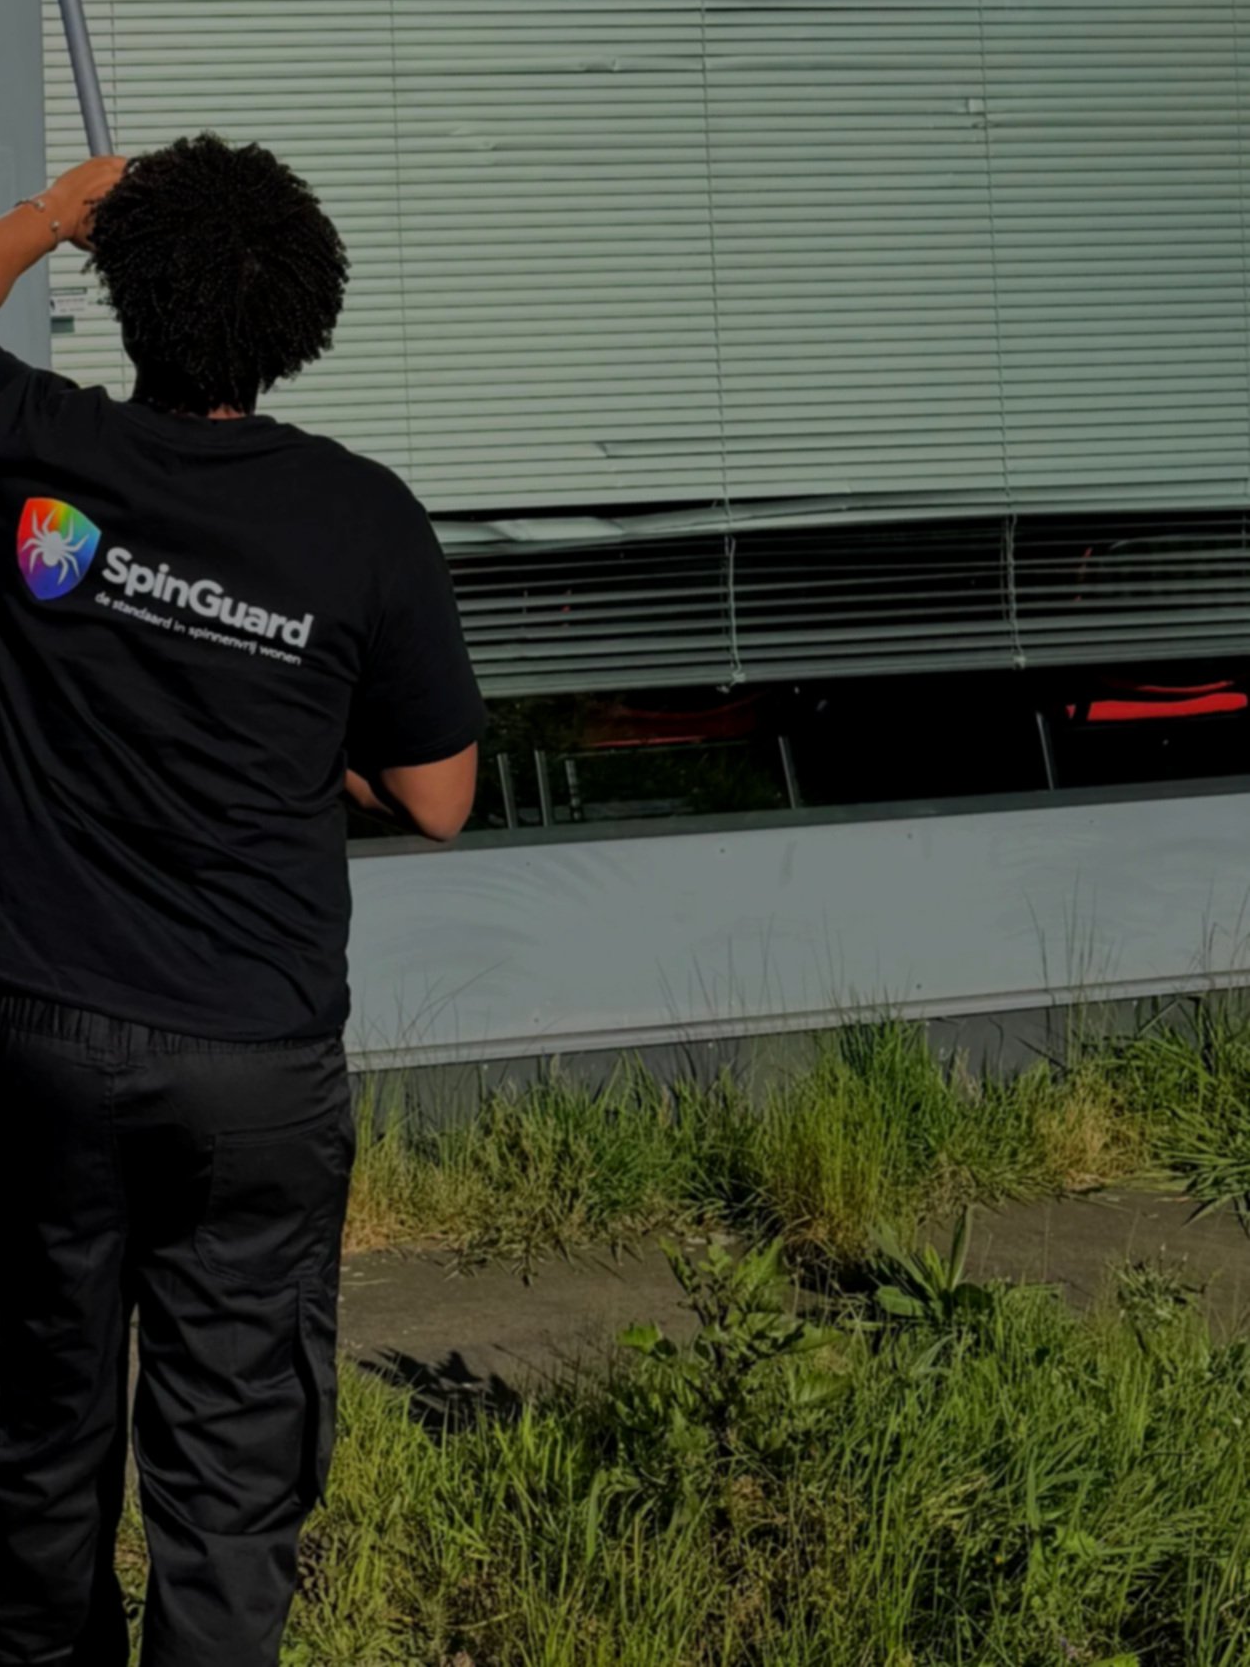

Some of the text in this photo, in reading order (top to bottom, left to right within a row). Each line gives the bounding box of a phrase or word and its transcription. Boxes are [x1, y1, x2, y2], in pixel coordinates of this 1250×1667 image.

[95, 591, 302, 665] de standaard in spinnenvrij wonen
[102, 547, 314, 648] SpinGuard
